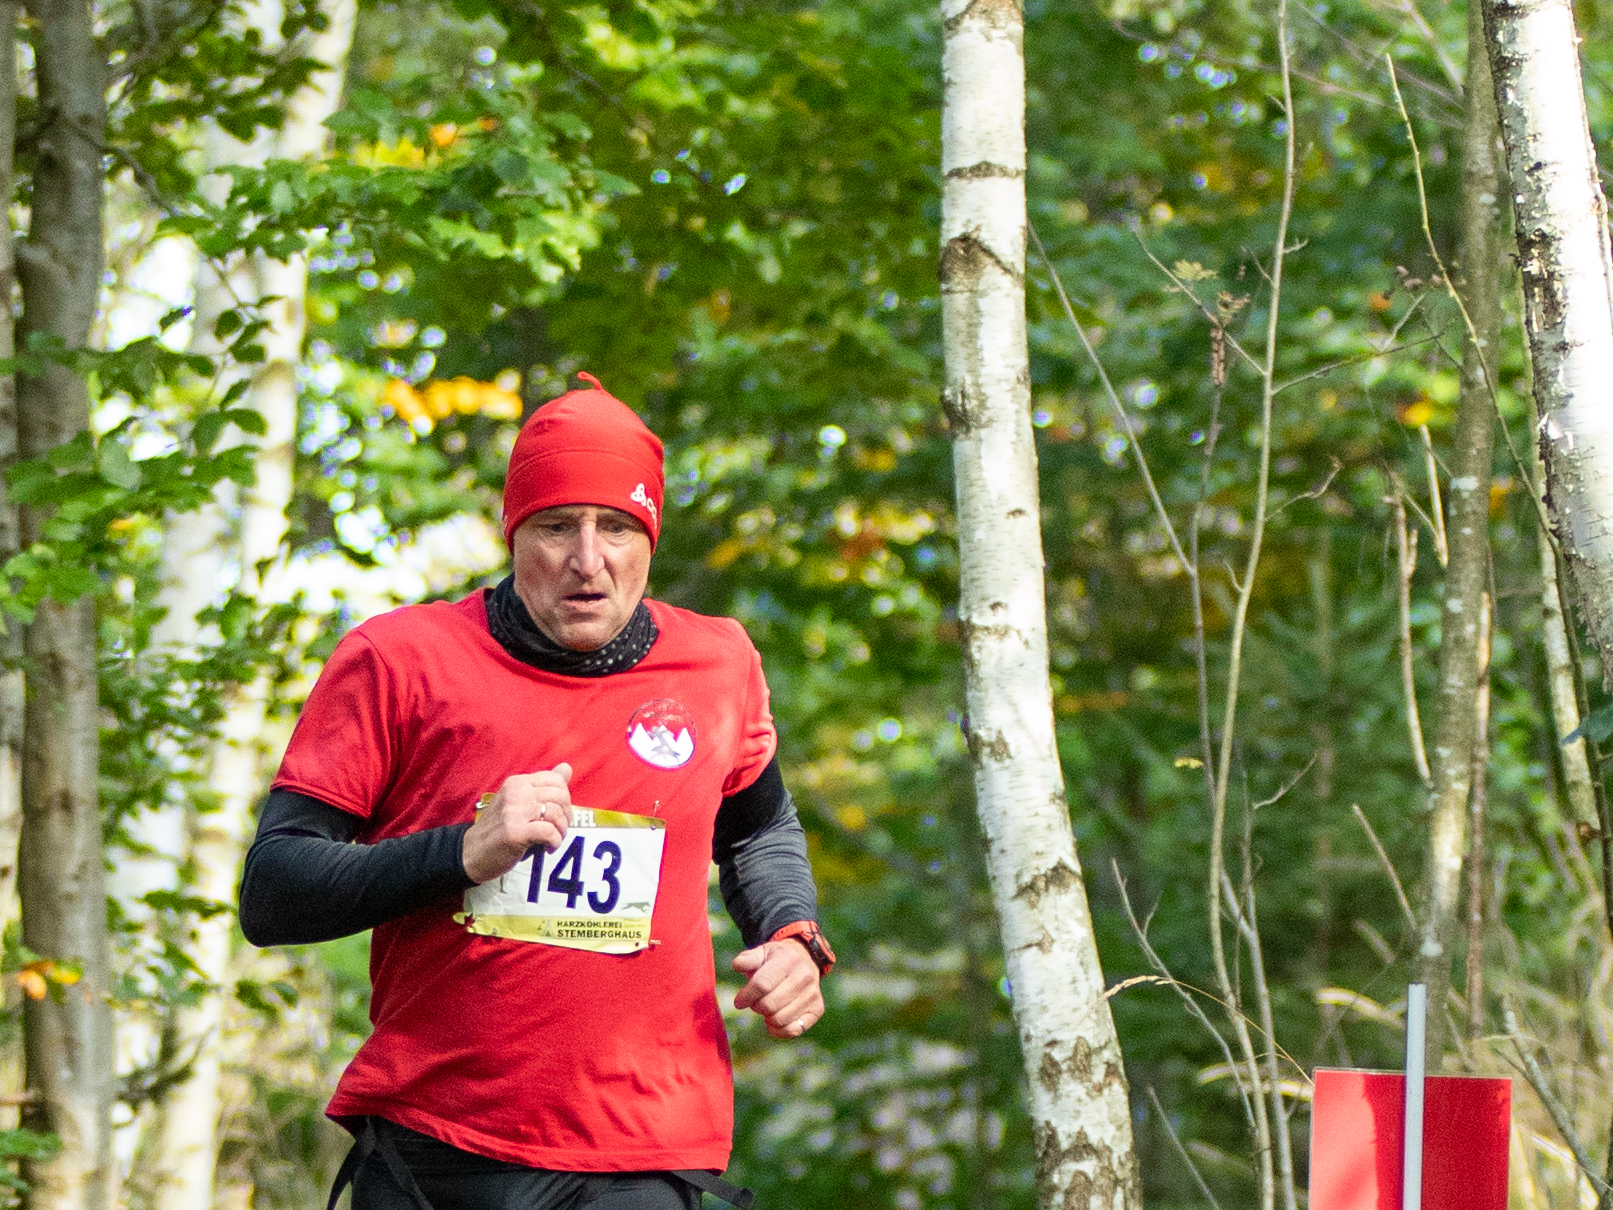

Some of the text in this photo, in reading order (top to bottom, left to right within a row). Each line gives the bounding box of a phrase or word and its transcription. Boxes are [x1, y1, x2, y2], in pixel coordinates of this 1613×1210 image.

[571, 809, 597, 828] FEL
[522, 835, 622, 914] 143
[557, 930, 642, 939] STEMBERGHAUS
